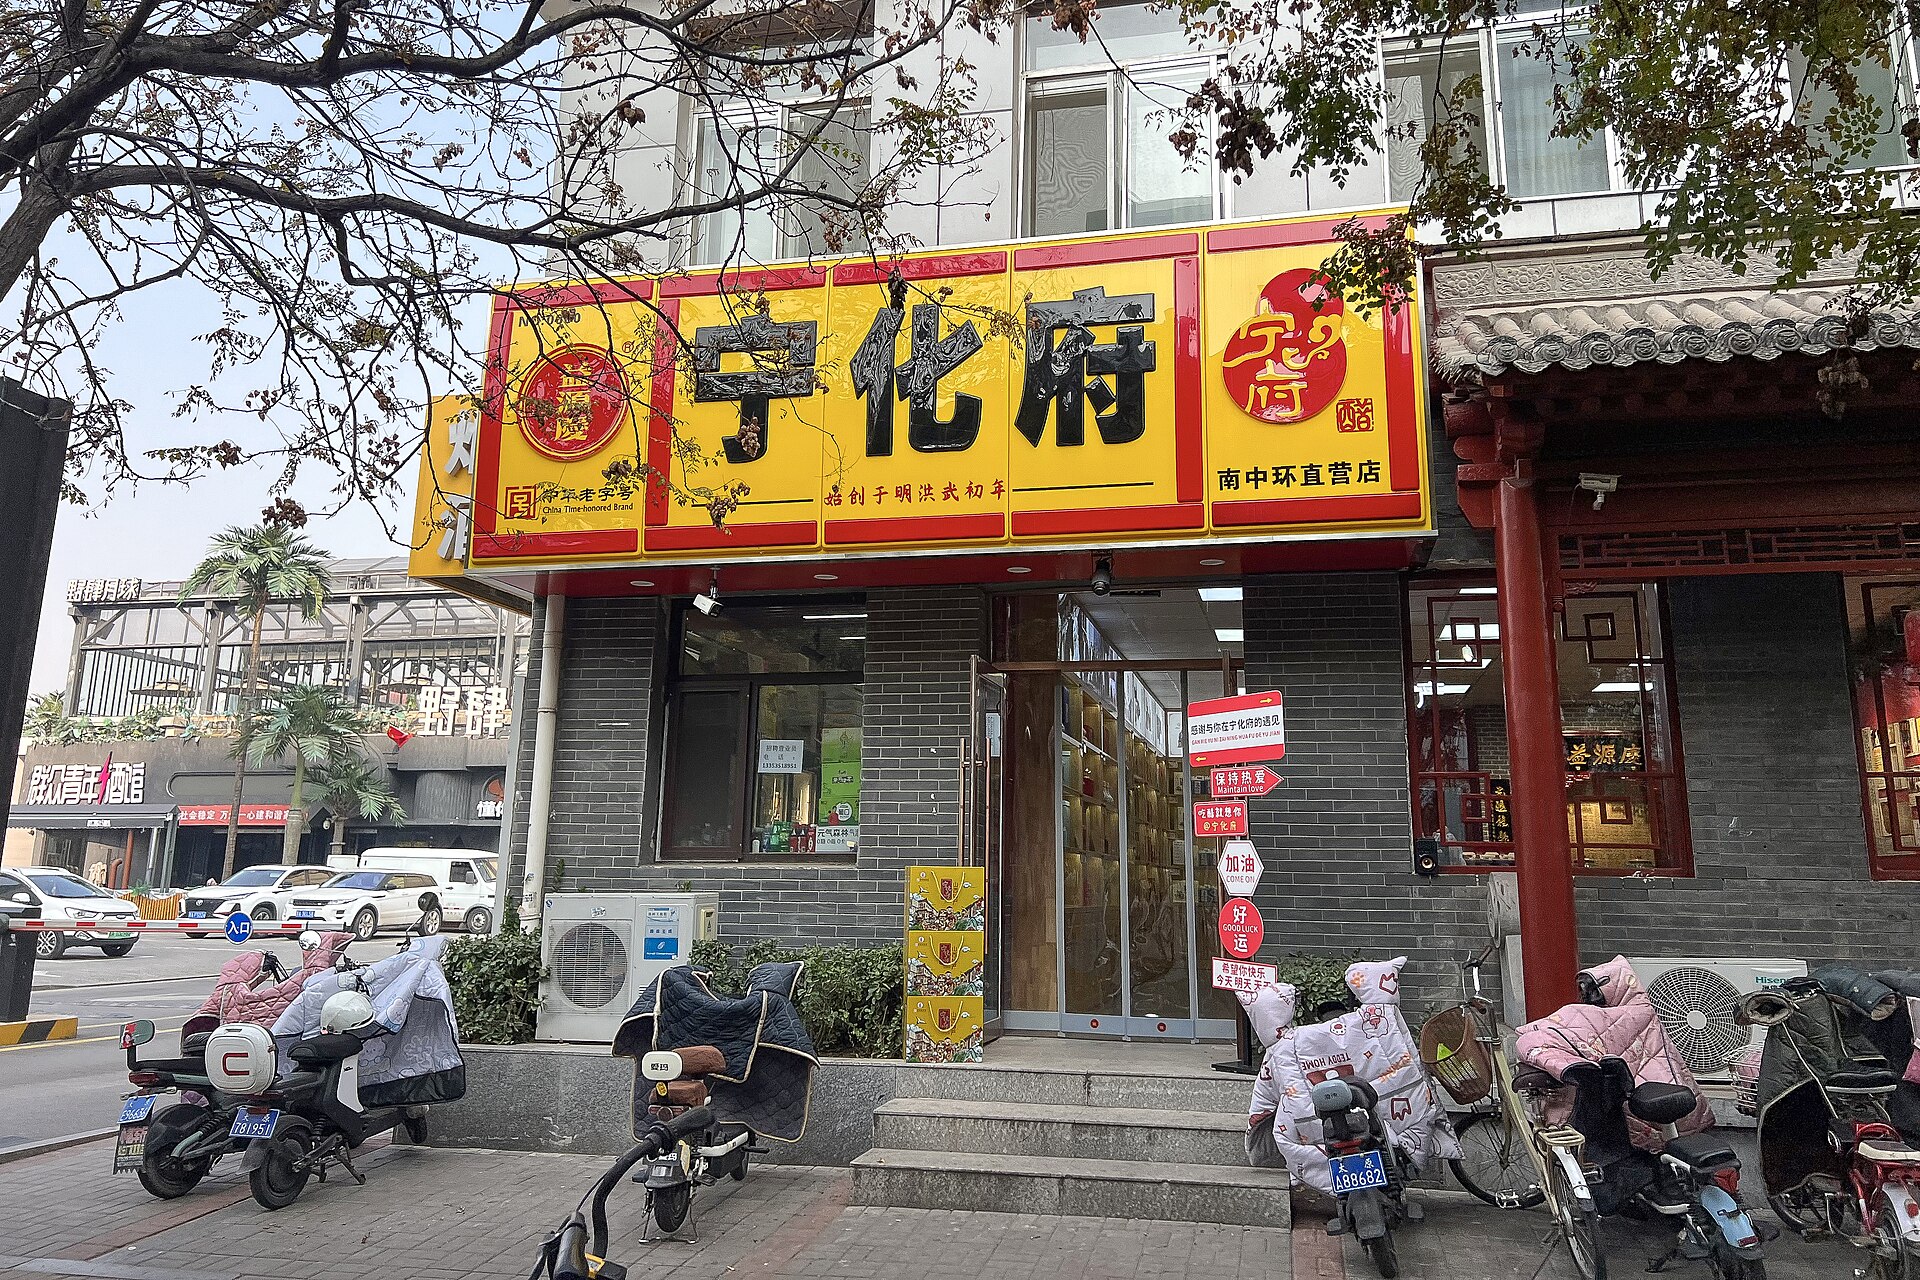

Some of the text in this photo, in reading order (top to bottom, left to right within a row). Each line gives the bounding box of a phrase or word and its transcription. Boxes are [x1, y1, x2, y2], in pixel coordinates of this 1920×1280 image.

[692, 286, 1157, 465] 宁化府
[1216, 459, 1382, 492] 南中环直营店
[823, 478, 1007, 507] 始创于明洪武初年
[542, 506, 562, 514] China
[613, 502, 634, 511] Brand
[1191, 714, 1281, 736] 感谢与你在宁化府的遇见
[1215, 769, 1266, 786] 保持热爱
[1217, 784, 1264, 794] Maintain love
[180, 810, 216, 820] 社会稳定
[1198, 806, 1242, 819] 吃醋就想你
[817, 828, 849, 838] 元气森林
[1225, 854, 1255, 873] 加油
[1226, 875, 1255, 883] COME ON
[227, 921, 250, 935] 入口
[1223, 923, 1258, 933] GOOD LUCK
[1222, 962, 1266, 979] 希望你快乐
[1216, 974, 1233, 987] 今天
[1234, 978, 1252, 991] 明天
[1755, 976, 1786, 984] Hisen
[1302, 1052, 1351, 1071] TEDDY HOME
[234, 1122, 271, 1136] 781951
[1338, 1157, 1374, 1173] 太原
[1336, 1168, 1383, 1191] A88682
